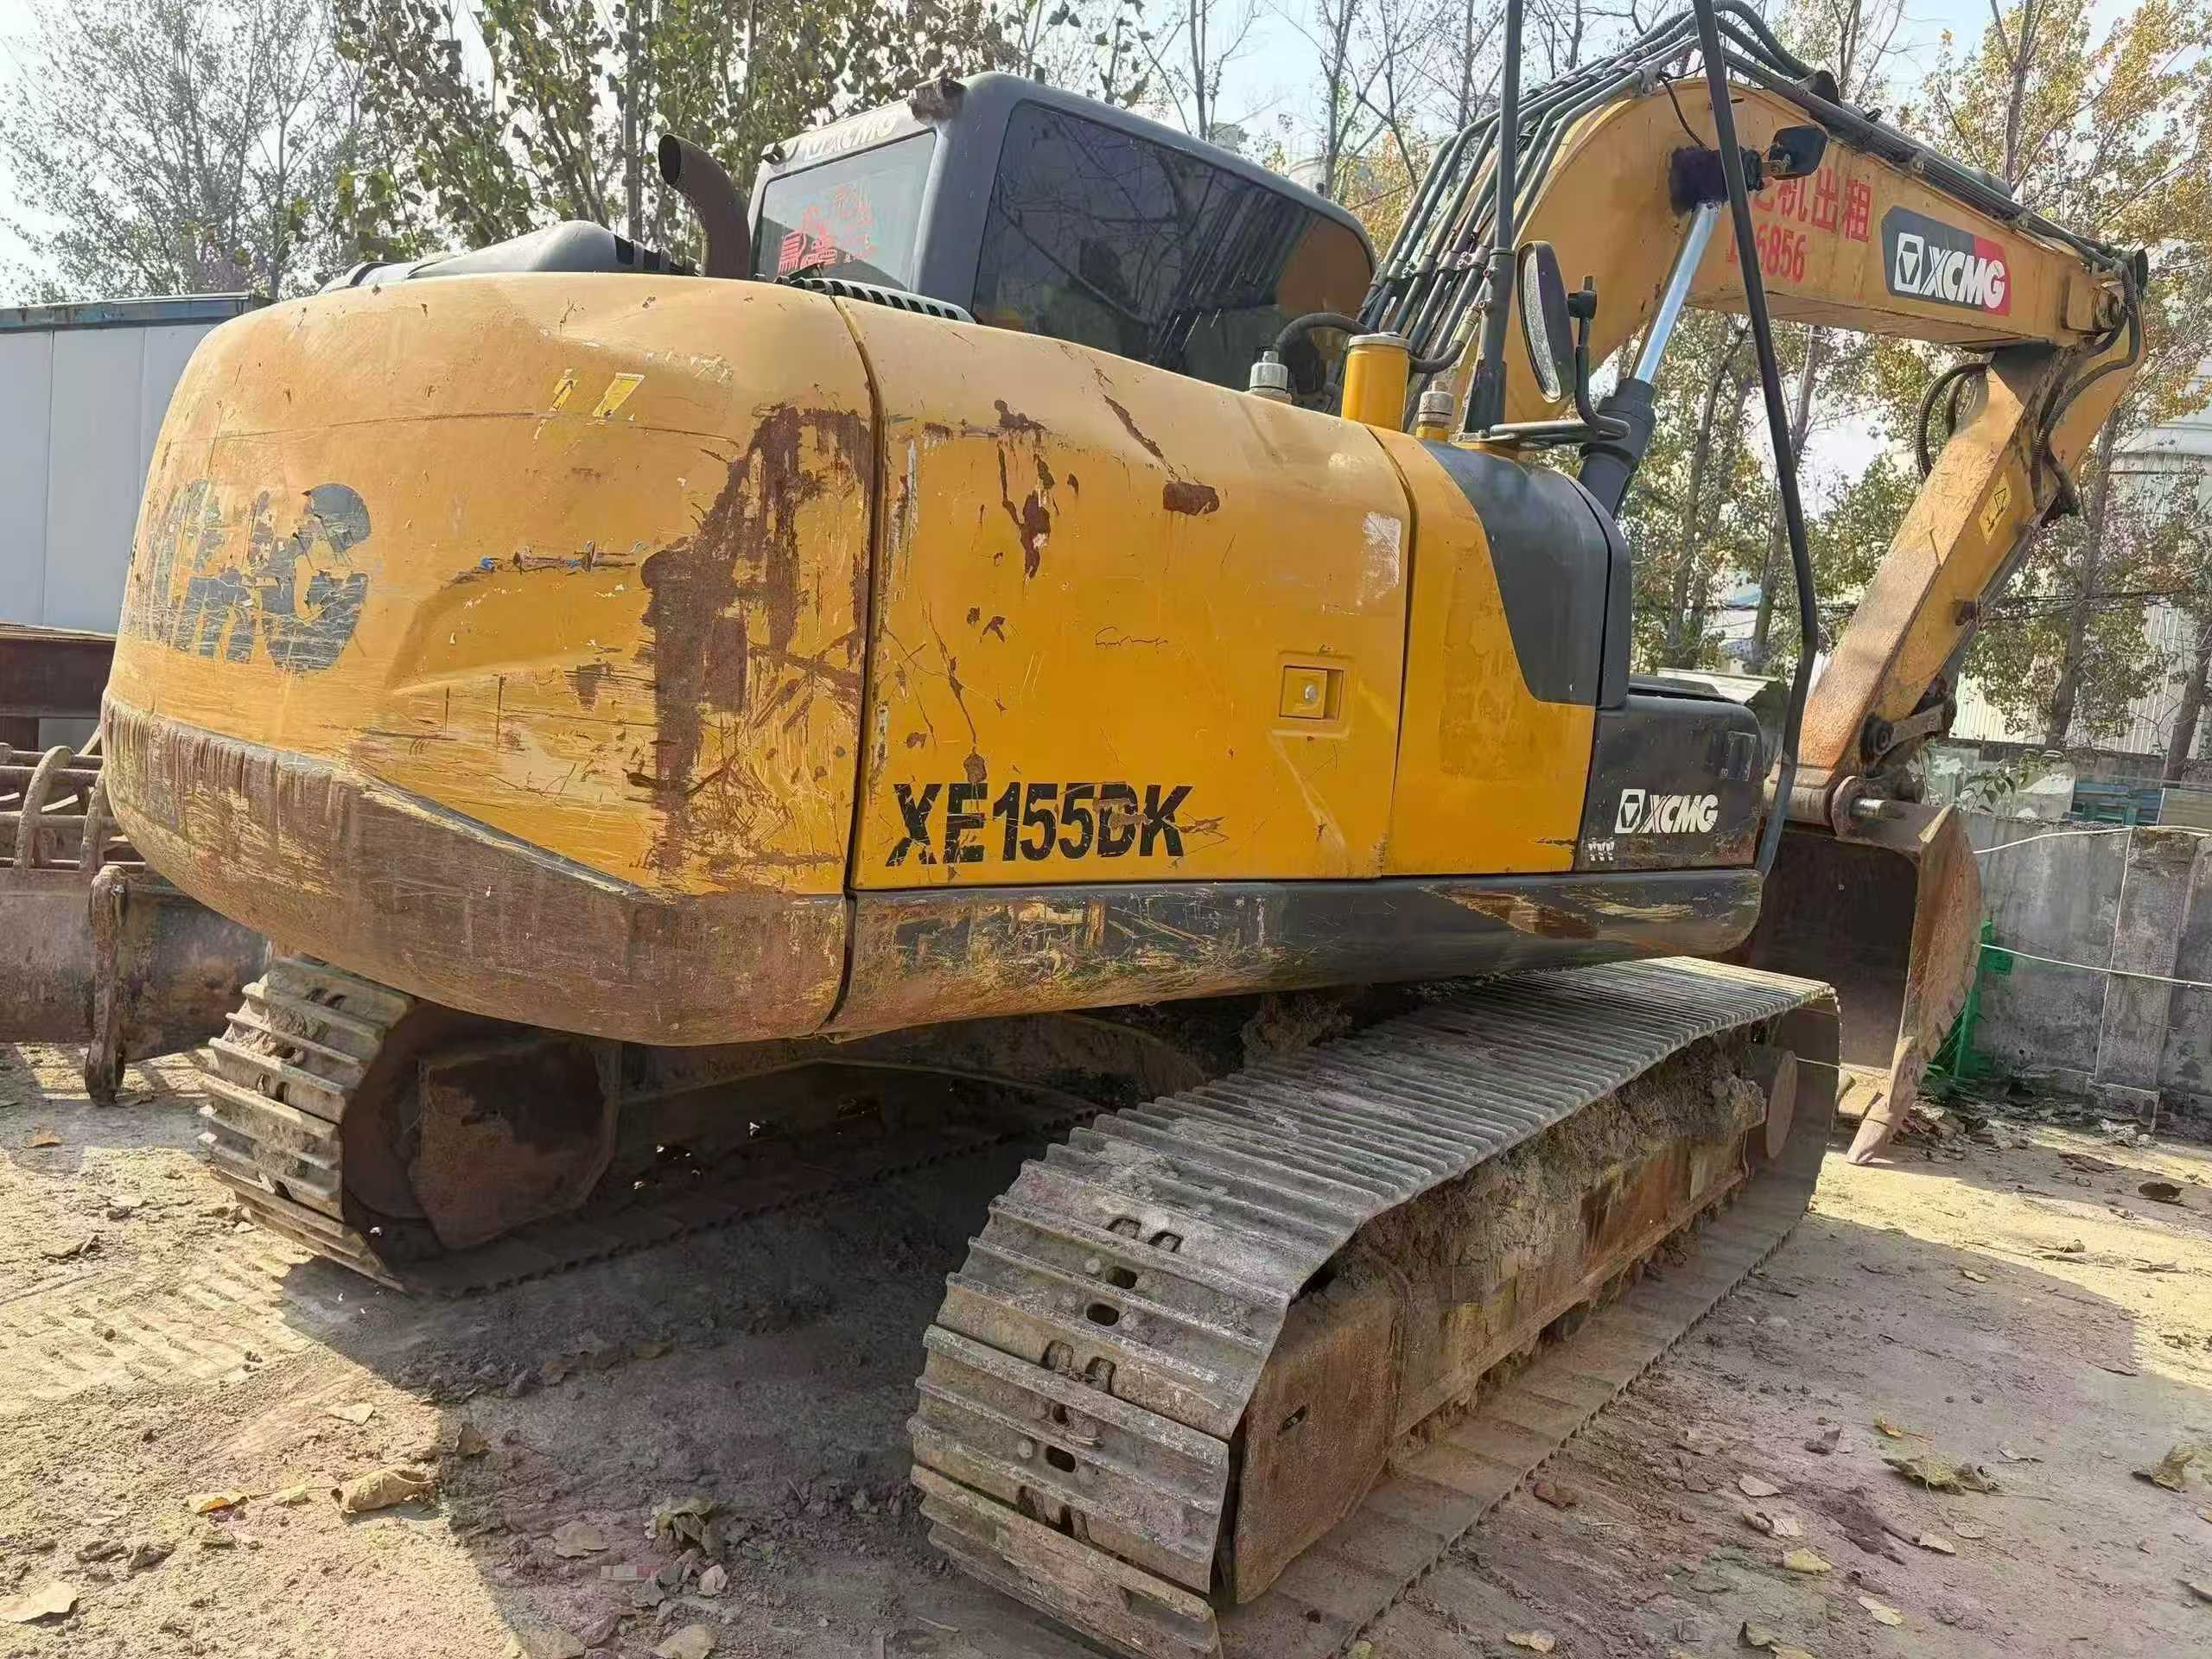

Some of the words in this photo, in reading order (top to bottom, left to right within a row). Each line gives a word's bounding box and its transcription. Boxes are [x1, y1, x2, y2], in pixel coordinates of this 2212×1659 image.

[1919, 245, 2005, 309] XCMG
[885, 781, 1193, 868] XE155DK
[1637, 793, 1719, 834] XCMG
